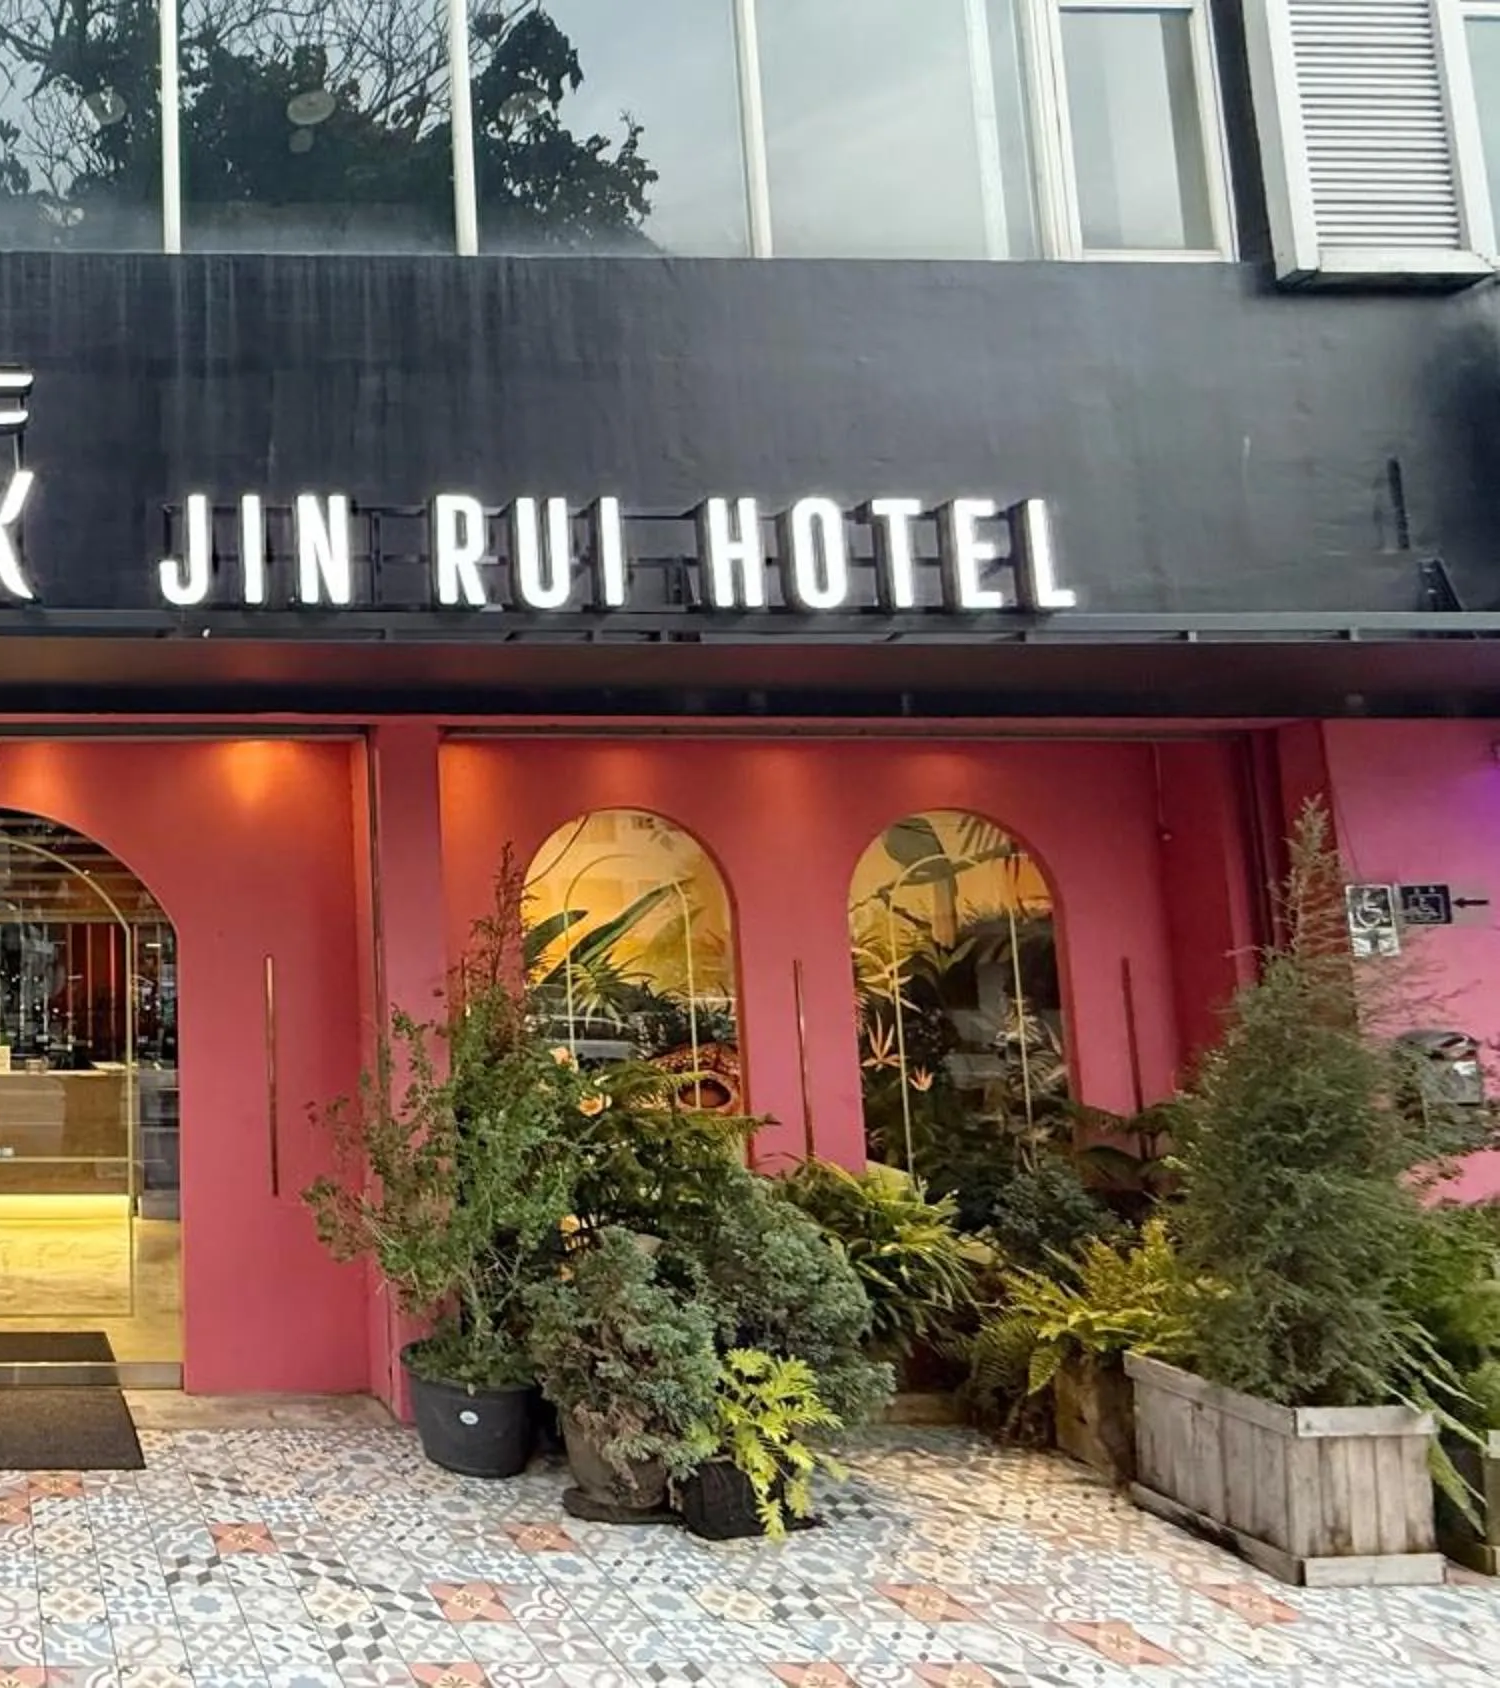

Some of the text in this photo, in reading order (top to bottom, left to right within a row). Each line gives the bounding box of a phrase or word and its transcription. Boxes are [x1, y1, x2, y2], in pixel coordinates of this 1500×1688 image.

[159, 494, 1077, 609] JIN RUI HOTEL
